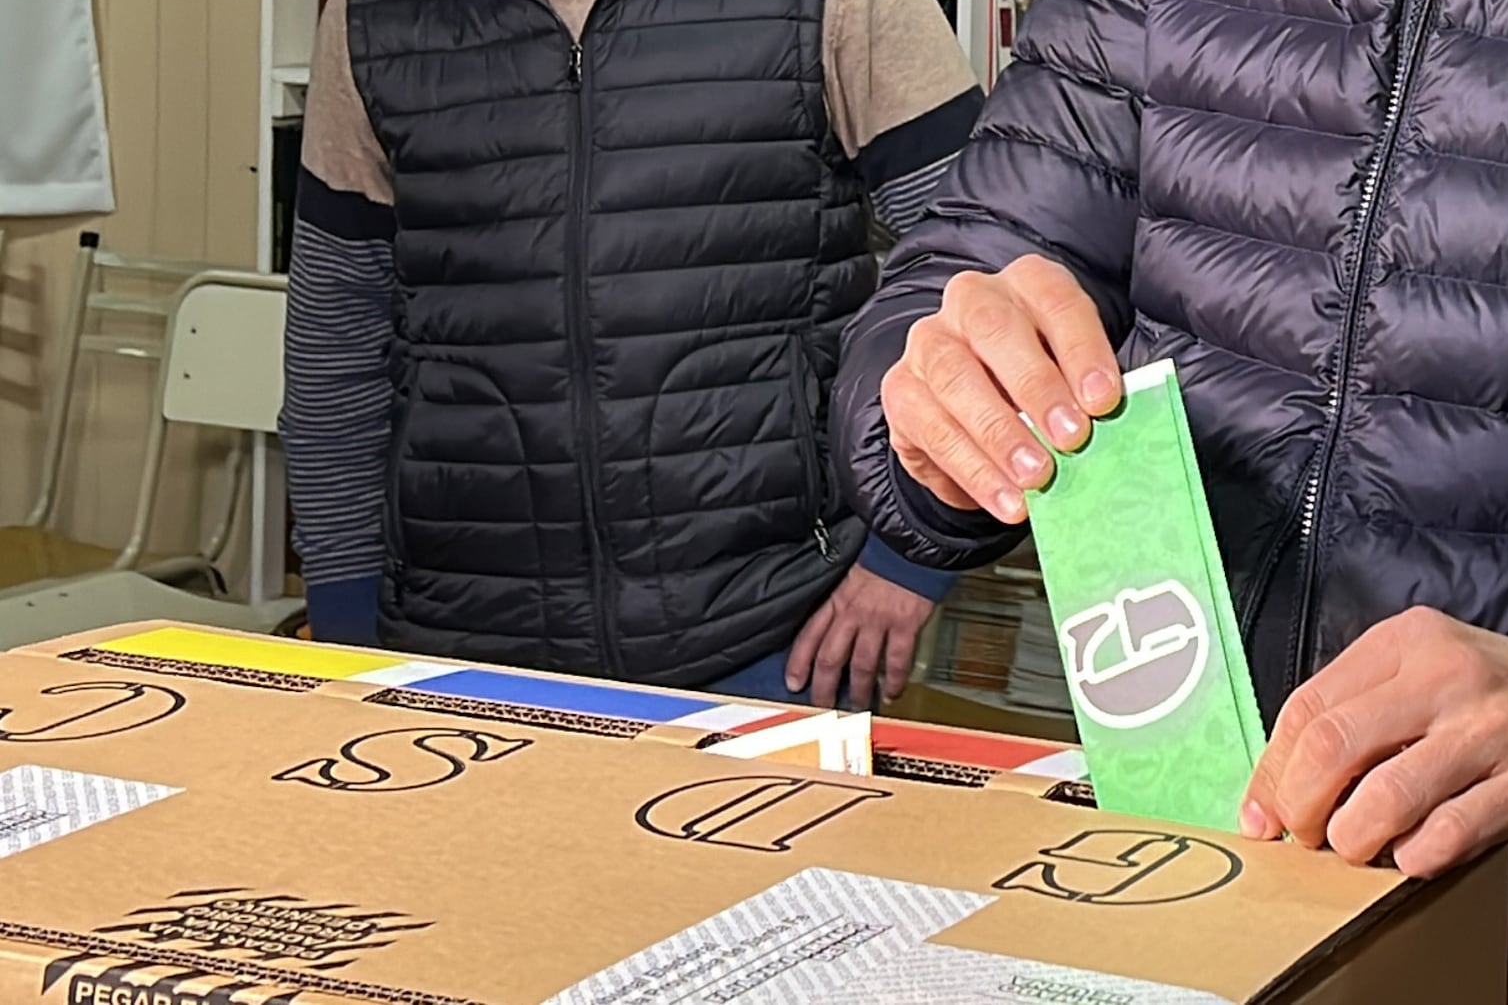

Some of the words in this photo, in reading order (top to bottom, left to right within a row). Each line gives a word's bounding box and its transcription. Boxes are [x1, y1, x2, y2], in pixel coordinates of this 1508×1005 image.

[186, 906, 363, 941] PROVISORIO
[213, 898, 373, 931] DEFINITIVO
[184, 916, 327, 946] ADHESIVA
[220, 936, 324, 960] PEGAR
